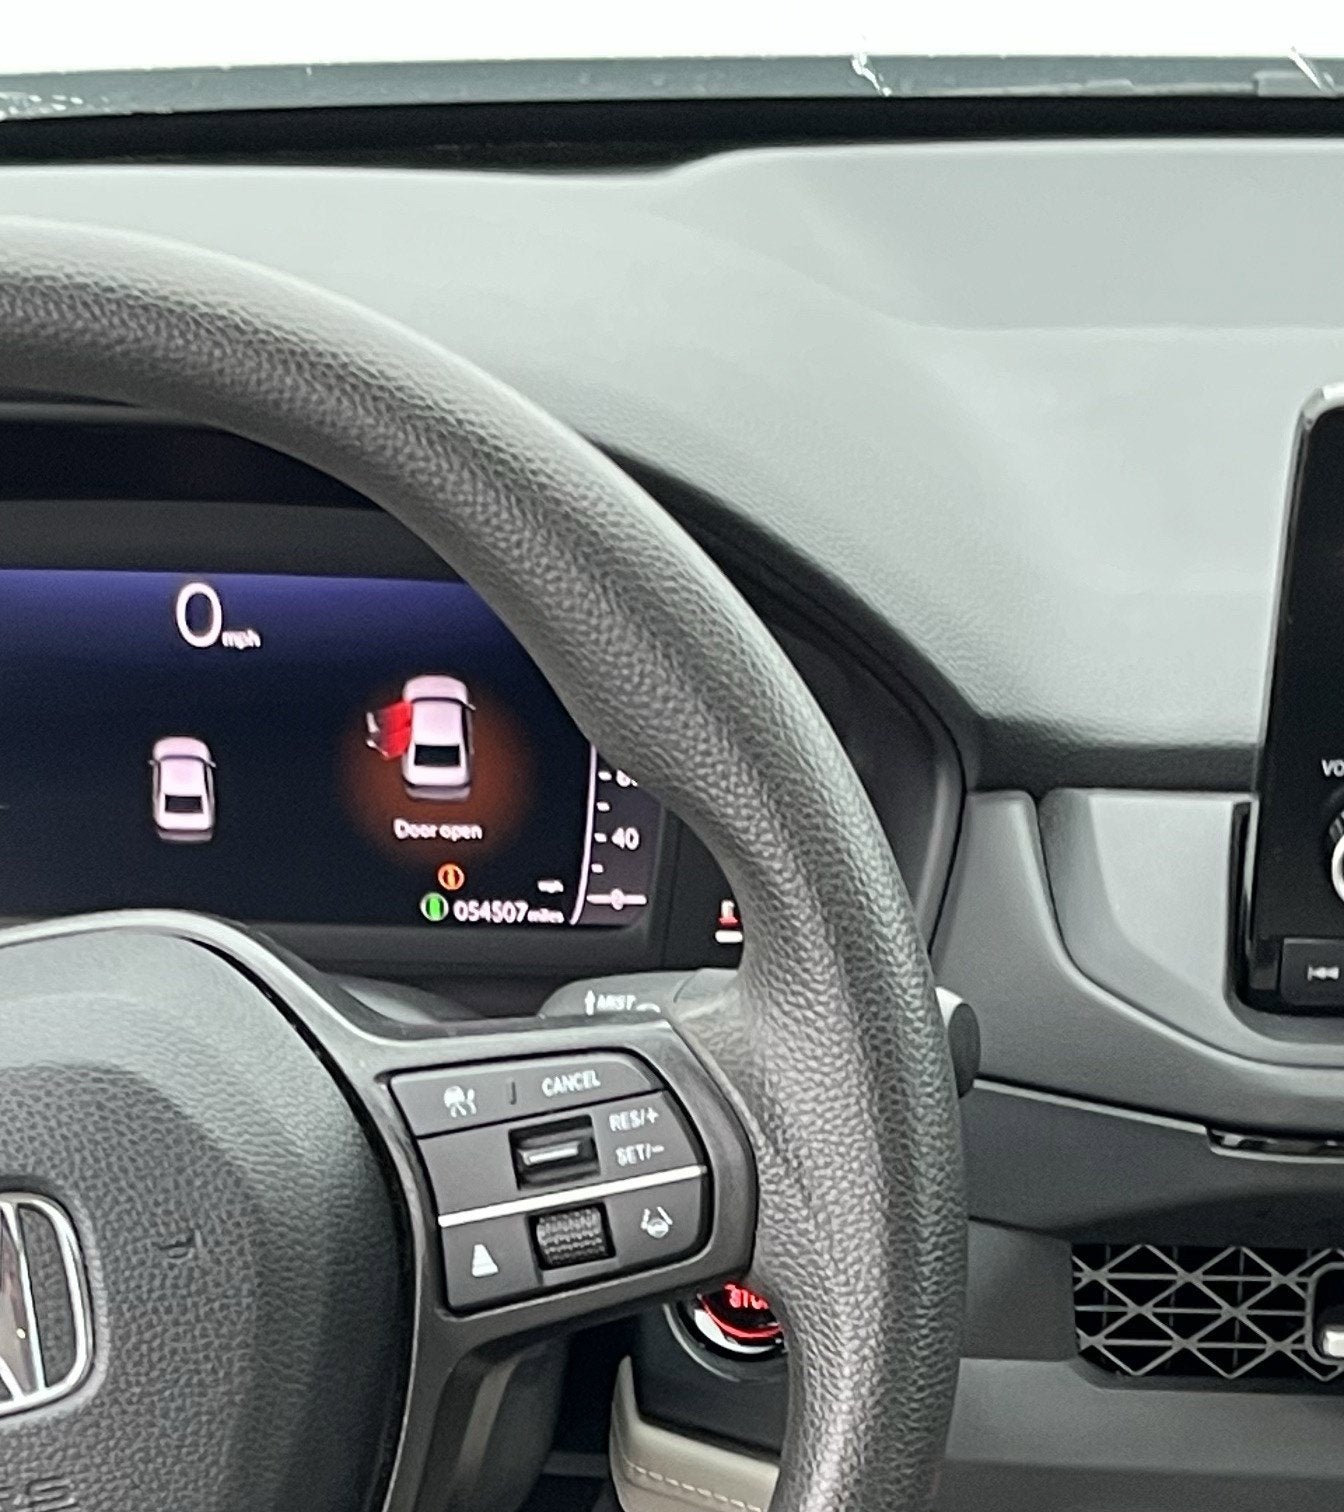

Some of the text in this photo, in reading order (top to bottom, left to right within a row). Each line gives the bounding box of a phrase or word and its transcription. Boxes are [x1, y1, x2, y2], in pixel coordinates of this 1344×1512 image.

[177, 582, 261, 650] 0 mph
[393, 819, 483, 842] Door open
[611, 827, 640, 850] 40
[453, 900, 528, 923] 054507
[542, 1070, 602, 1097] CANCEL
